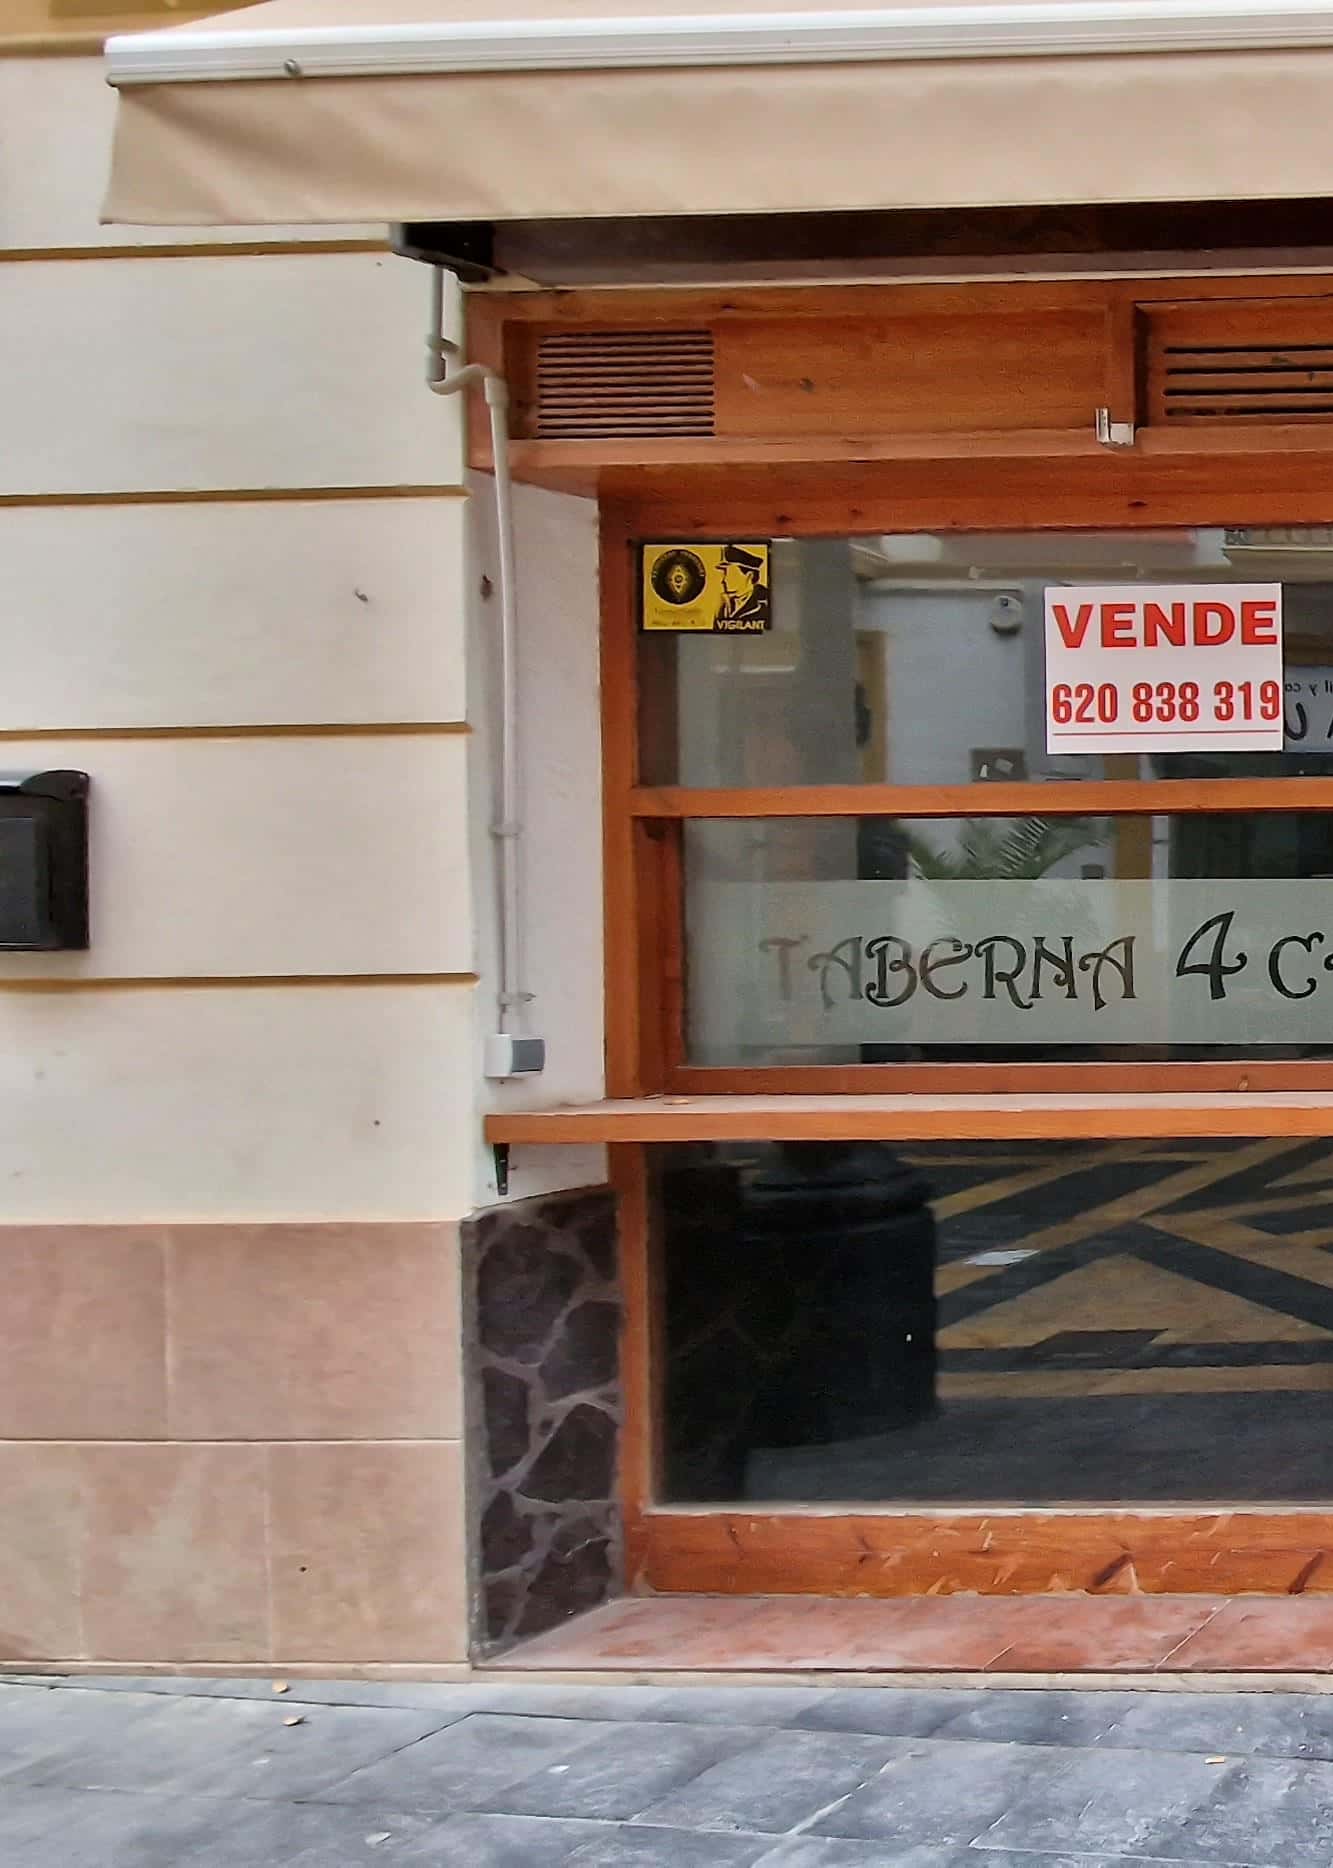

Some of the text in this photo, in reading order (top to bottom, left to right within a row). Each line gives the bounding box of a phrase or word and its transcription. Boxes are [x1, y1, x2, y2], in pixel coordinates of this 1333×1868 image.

[1052, 601, 1278, 648] VENDE
[1052, 680, 1280, 723] 620 838 319
[759, 935, 1137, 1011] TABERNA
[1175, 910, 1248, 1001] 4
